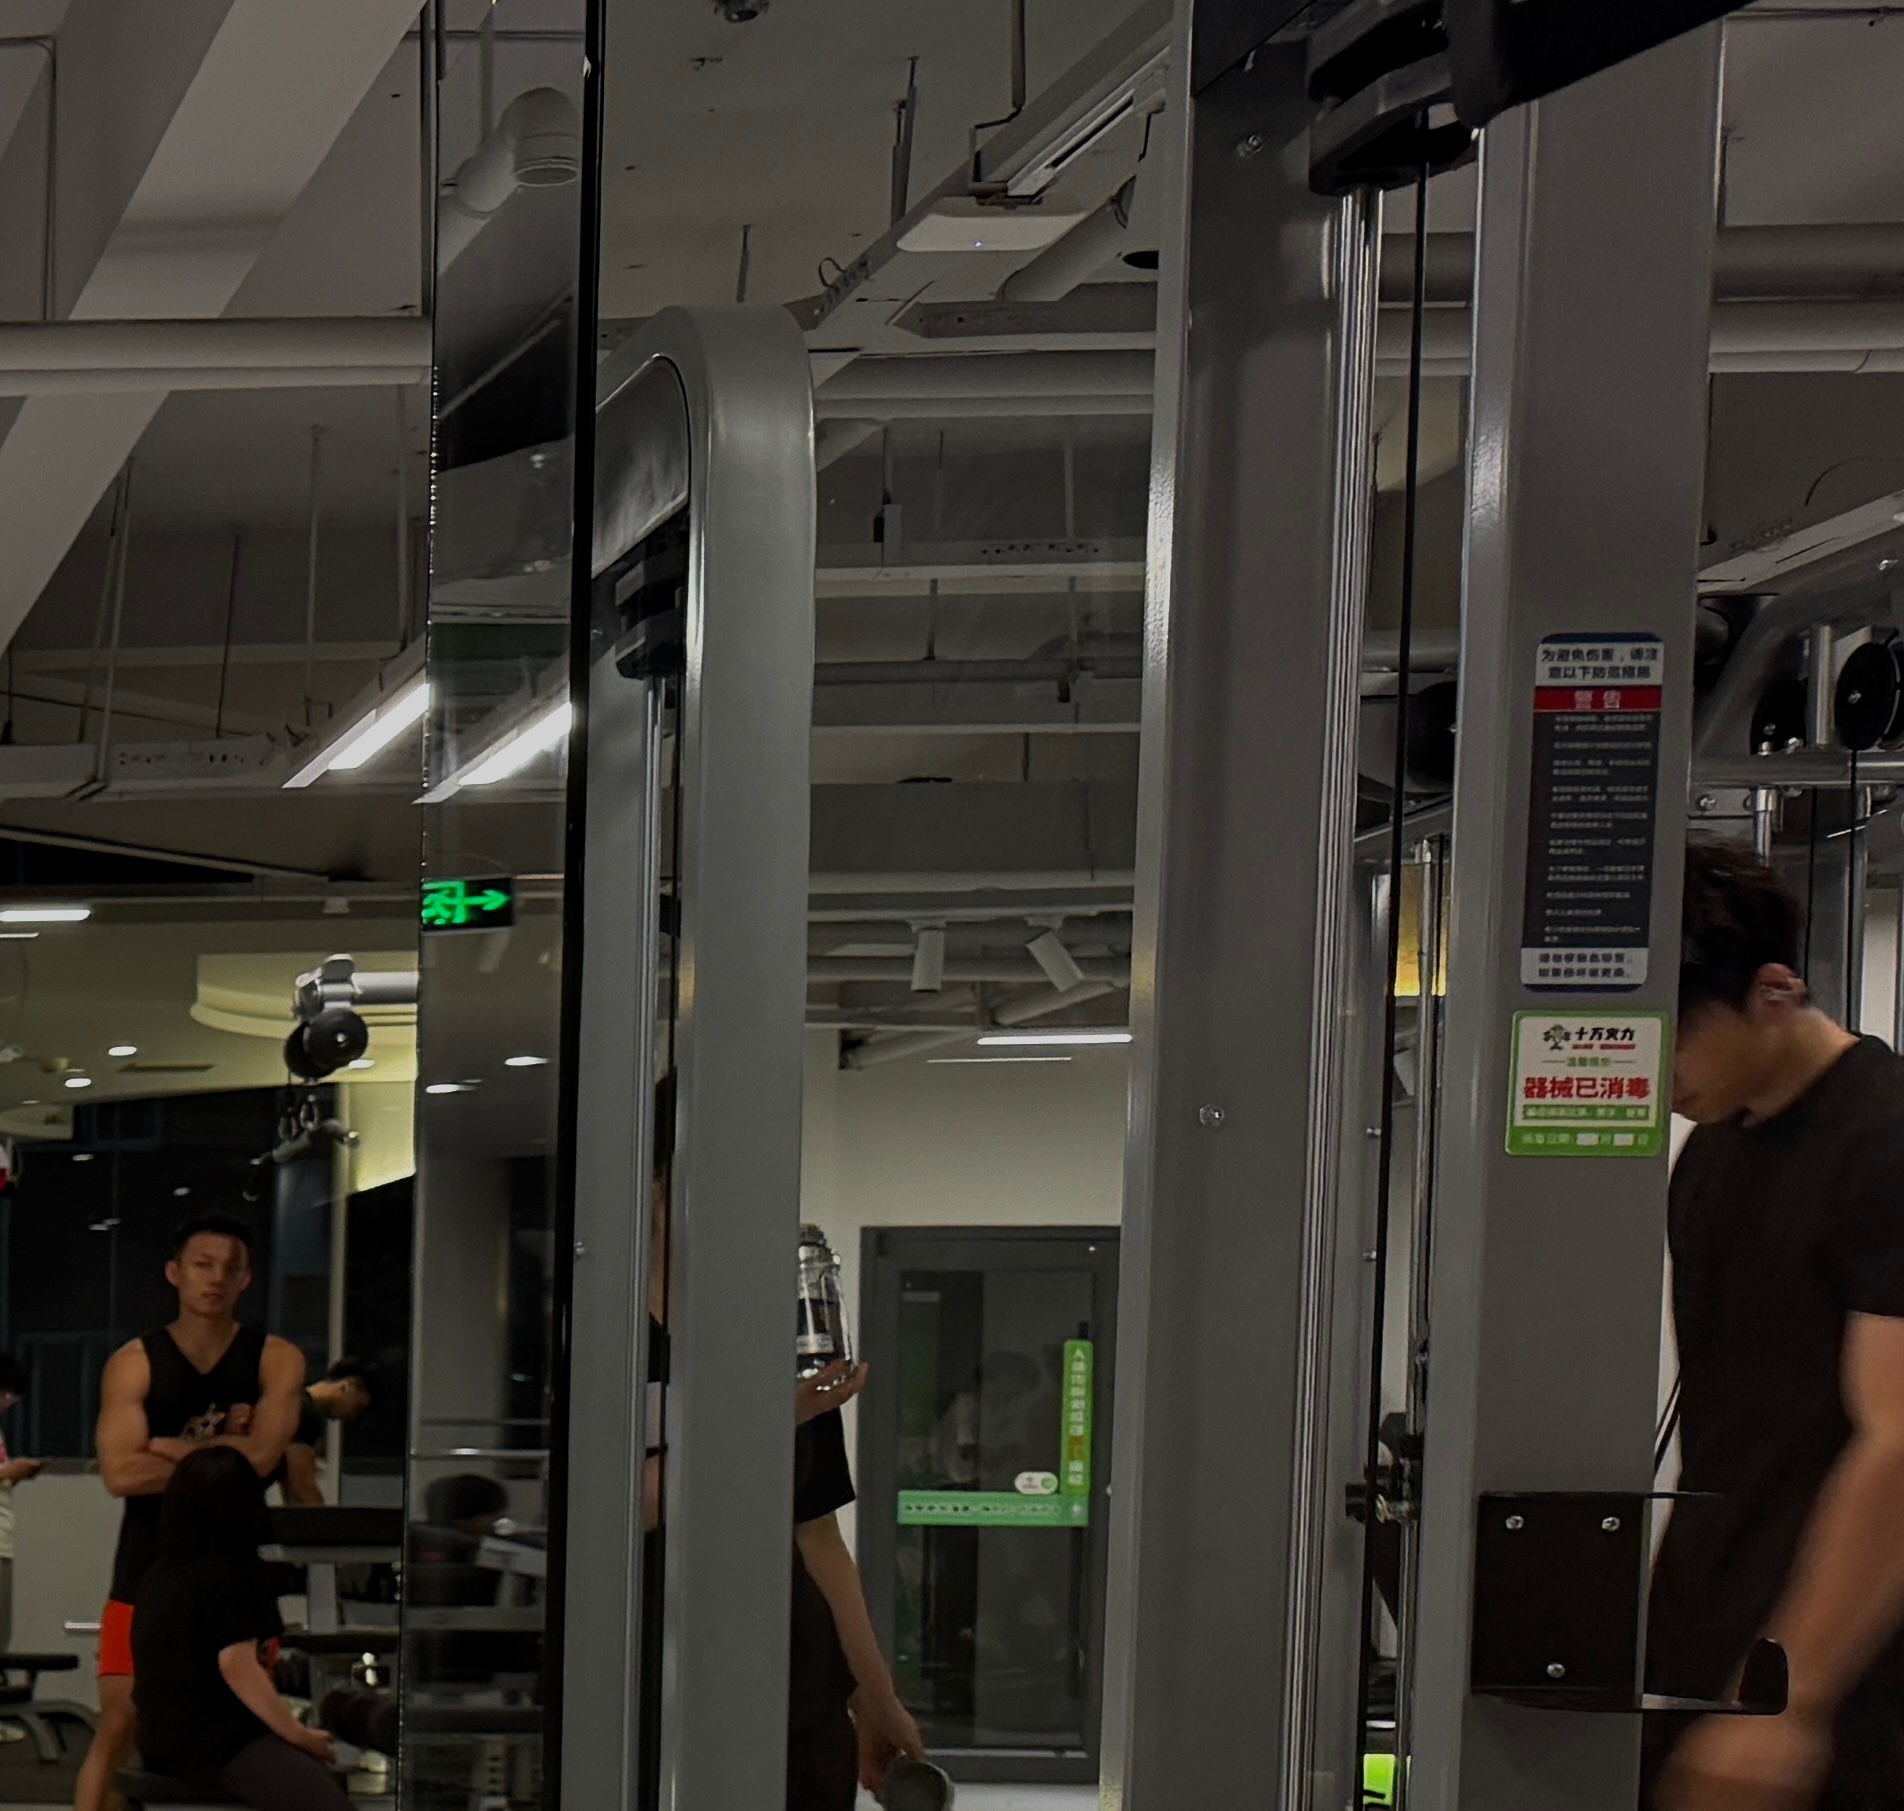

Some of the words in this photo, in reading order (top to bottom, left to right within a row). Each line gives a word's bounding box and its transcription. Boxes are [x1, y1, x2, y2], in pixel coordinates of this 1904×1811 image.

[1574, 1026, 1636, 1041] 十万火力
[1523, 1076, 1651, 1100] 器械已消毒
